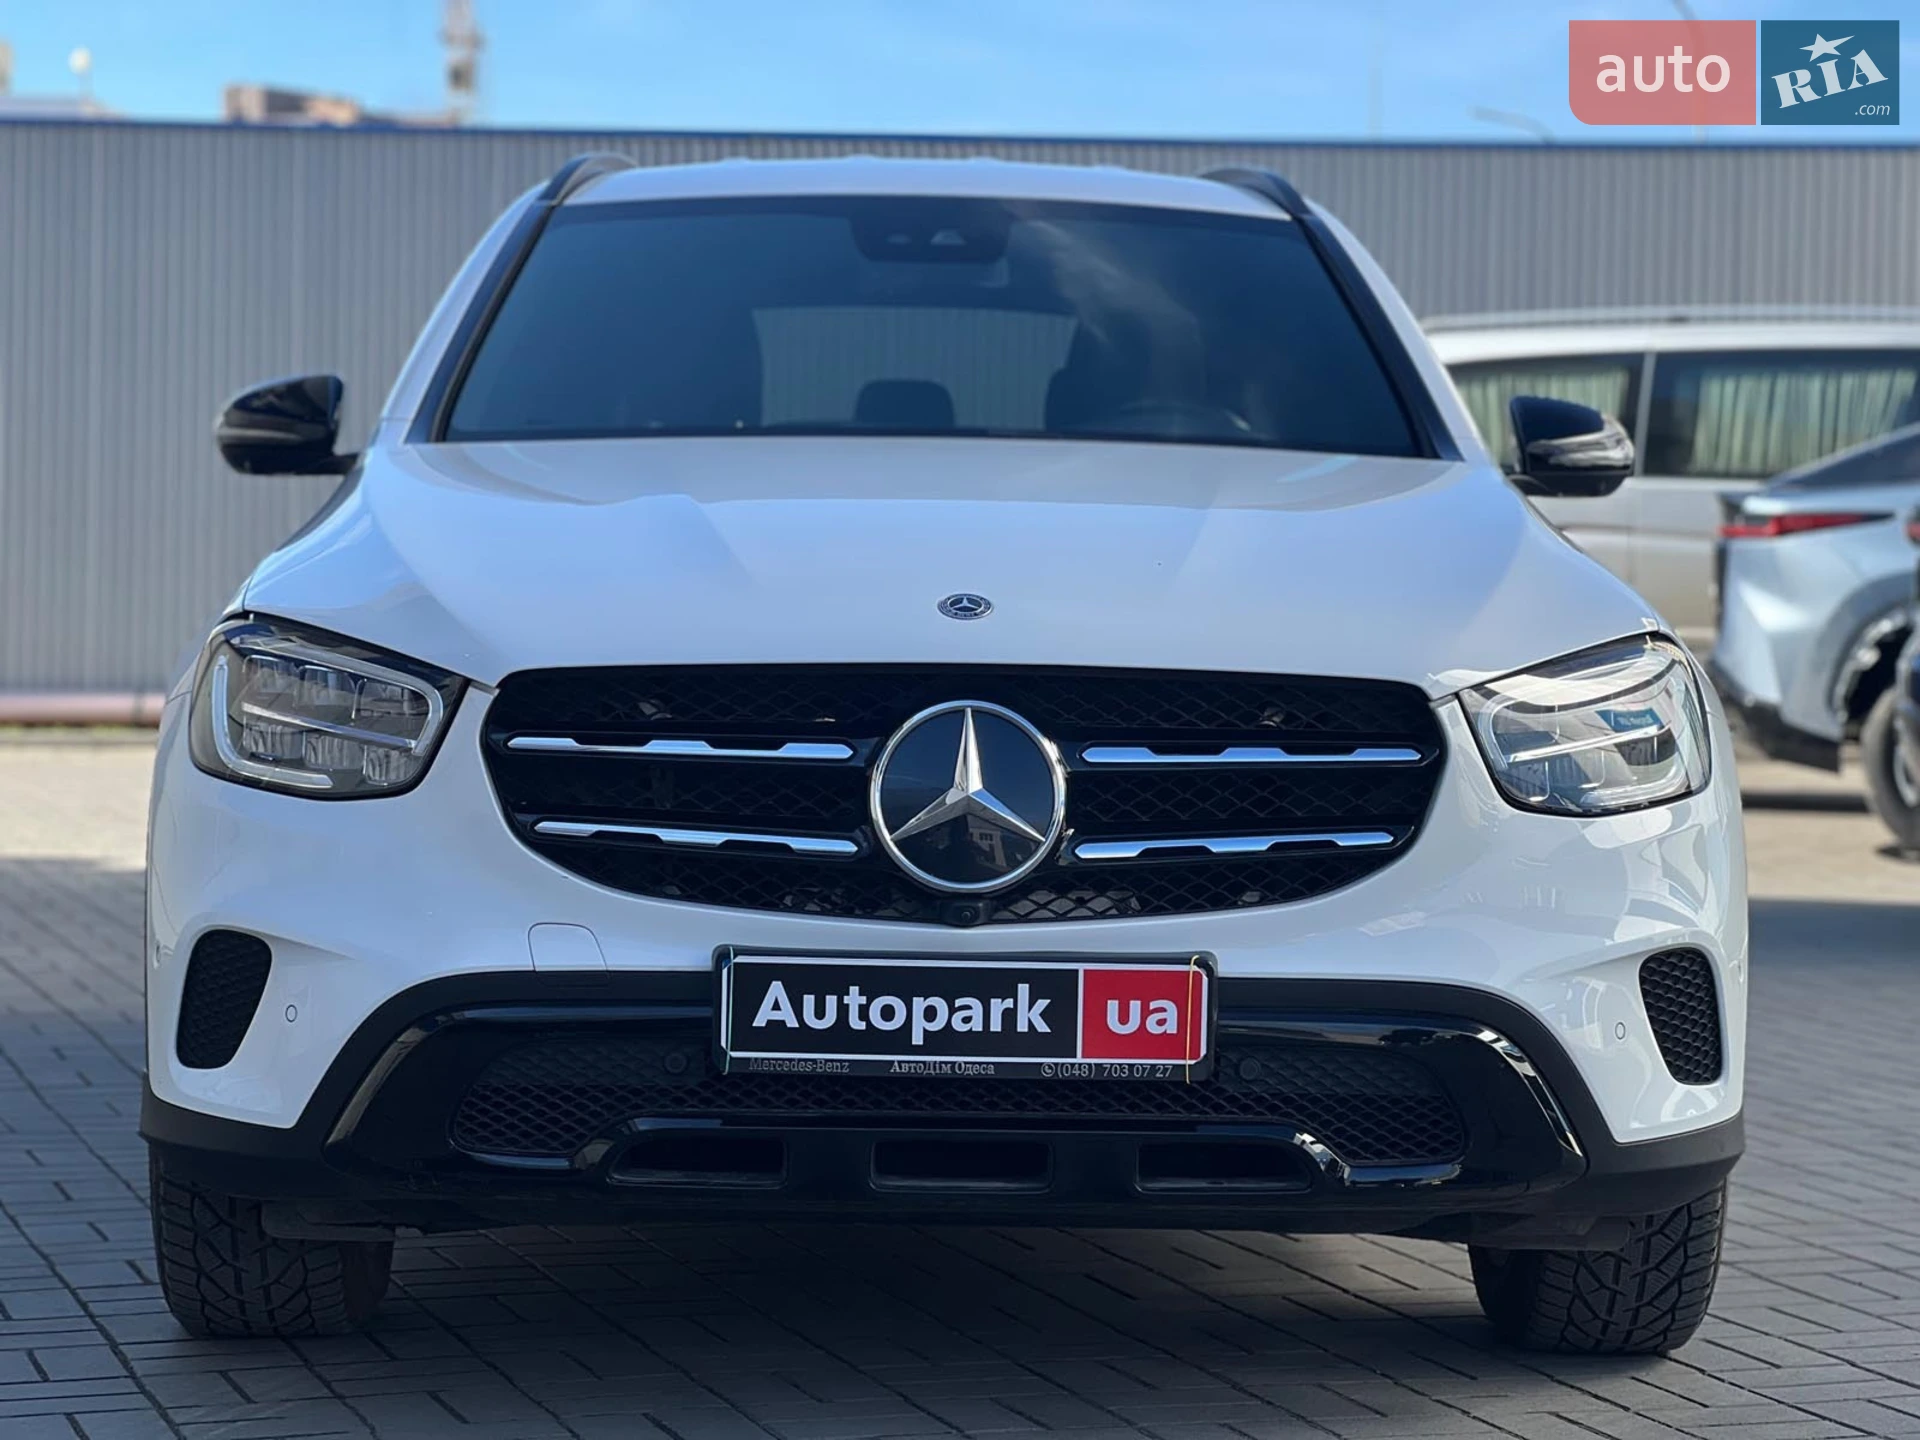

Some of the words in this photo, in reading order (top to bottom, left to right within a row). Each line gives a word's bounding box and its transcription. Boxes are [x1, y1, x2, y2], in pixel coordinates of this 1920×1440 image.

[752, 980, 1052, 1046] Autopark
[1106, 998, 1179, 1035] ua
[748, 1057, 850, 1073] Mercedes-Benz
[890, 1060, 952, 1076] АвтоДім
[955, 1061, 995, 1076] Одеса
[1057, 1062, 1096, 1078] (048)
[1102, 1064, 1129, 1077] 703
[1133, 1064, 1151, 1077] 07
[1155, 1065, 1173, 1077] 27
